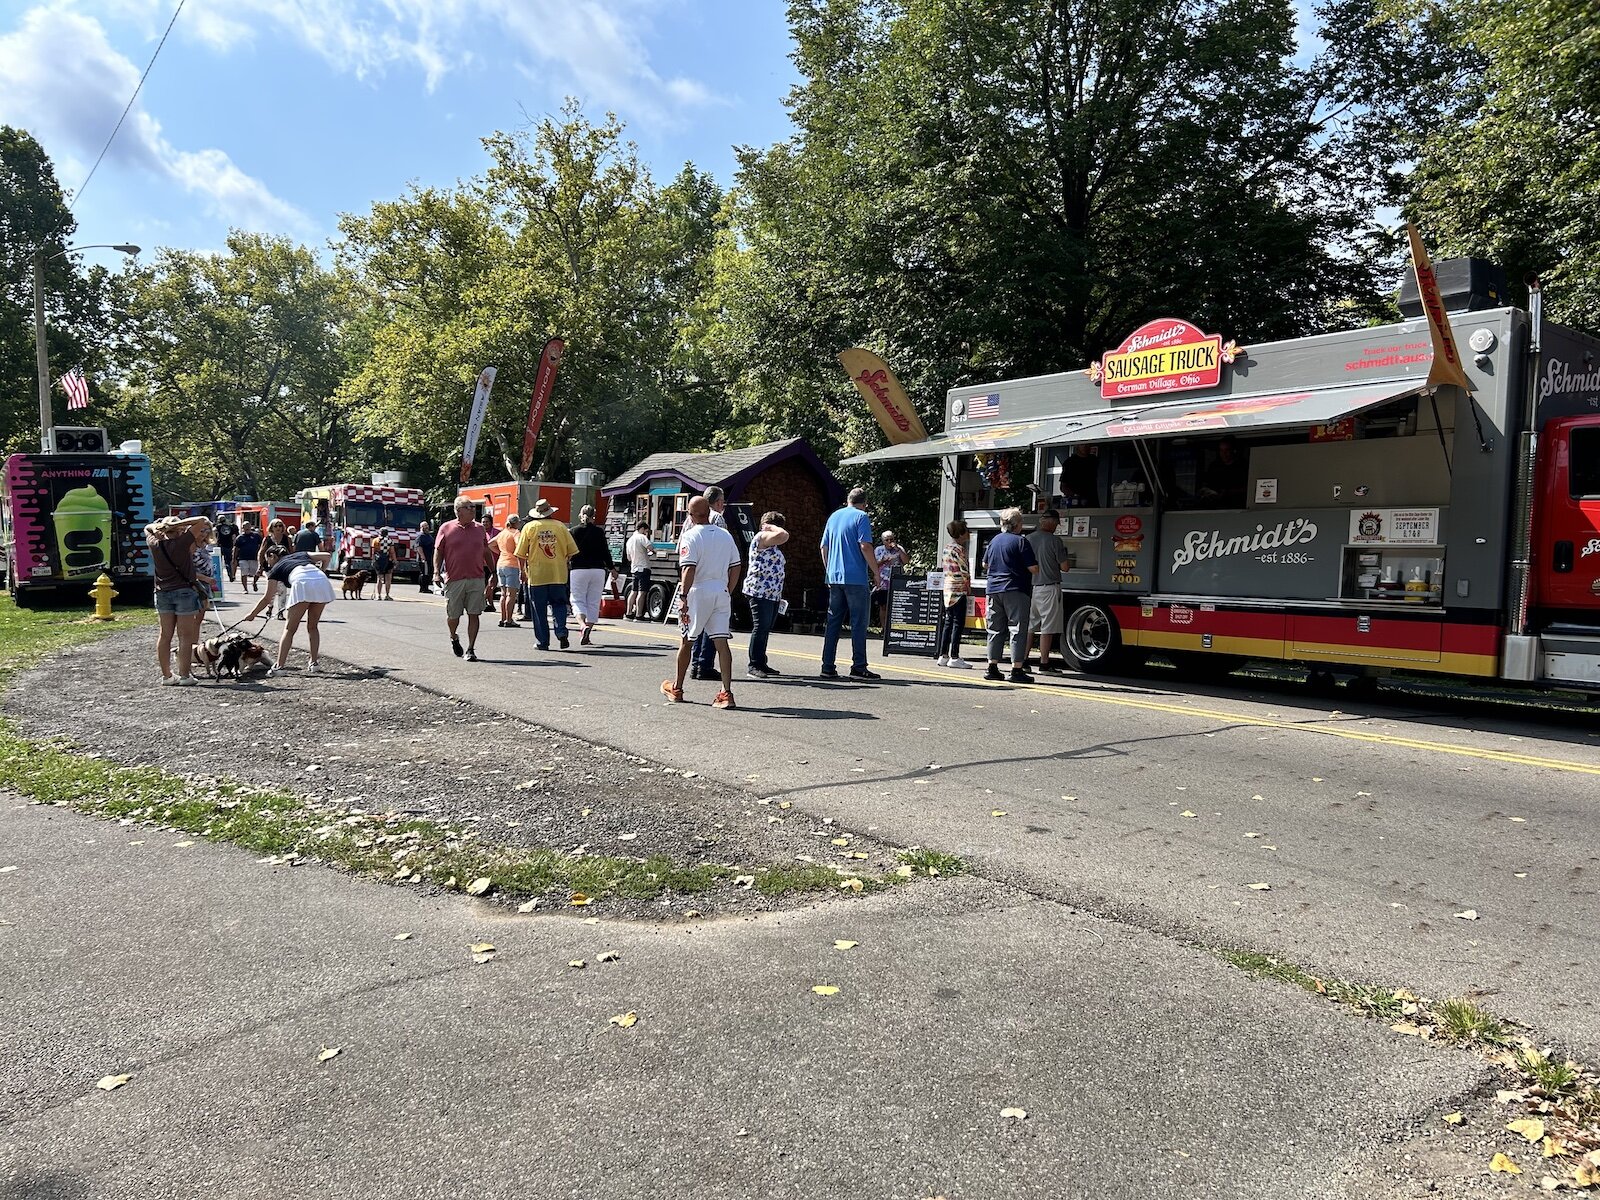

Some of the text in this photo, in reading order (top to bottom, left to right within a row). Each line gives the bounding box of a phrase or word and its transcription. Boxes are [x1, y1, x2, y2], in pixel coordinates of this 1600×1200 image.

[1127, 324, 1186, 353] Schmidt's
[1106, 346, 1215, 380] SAUSAGE TRUCK
[1117, 379, 1147, 394] German
[1180, 373, 1201, 386] Ohio
[41, 469, 91, 478] ANYTHING
[1396, 522, 1430, 530] SEPTEMBER
[1171, 517, 1318, 575] Schmidt's
[1116, 560, 1137, 568] MAN
[1111, 576, 1141, 584] FOOD
